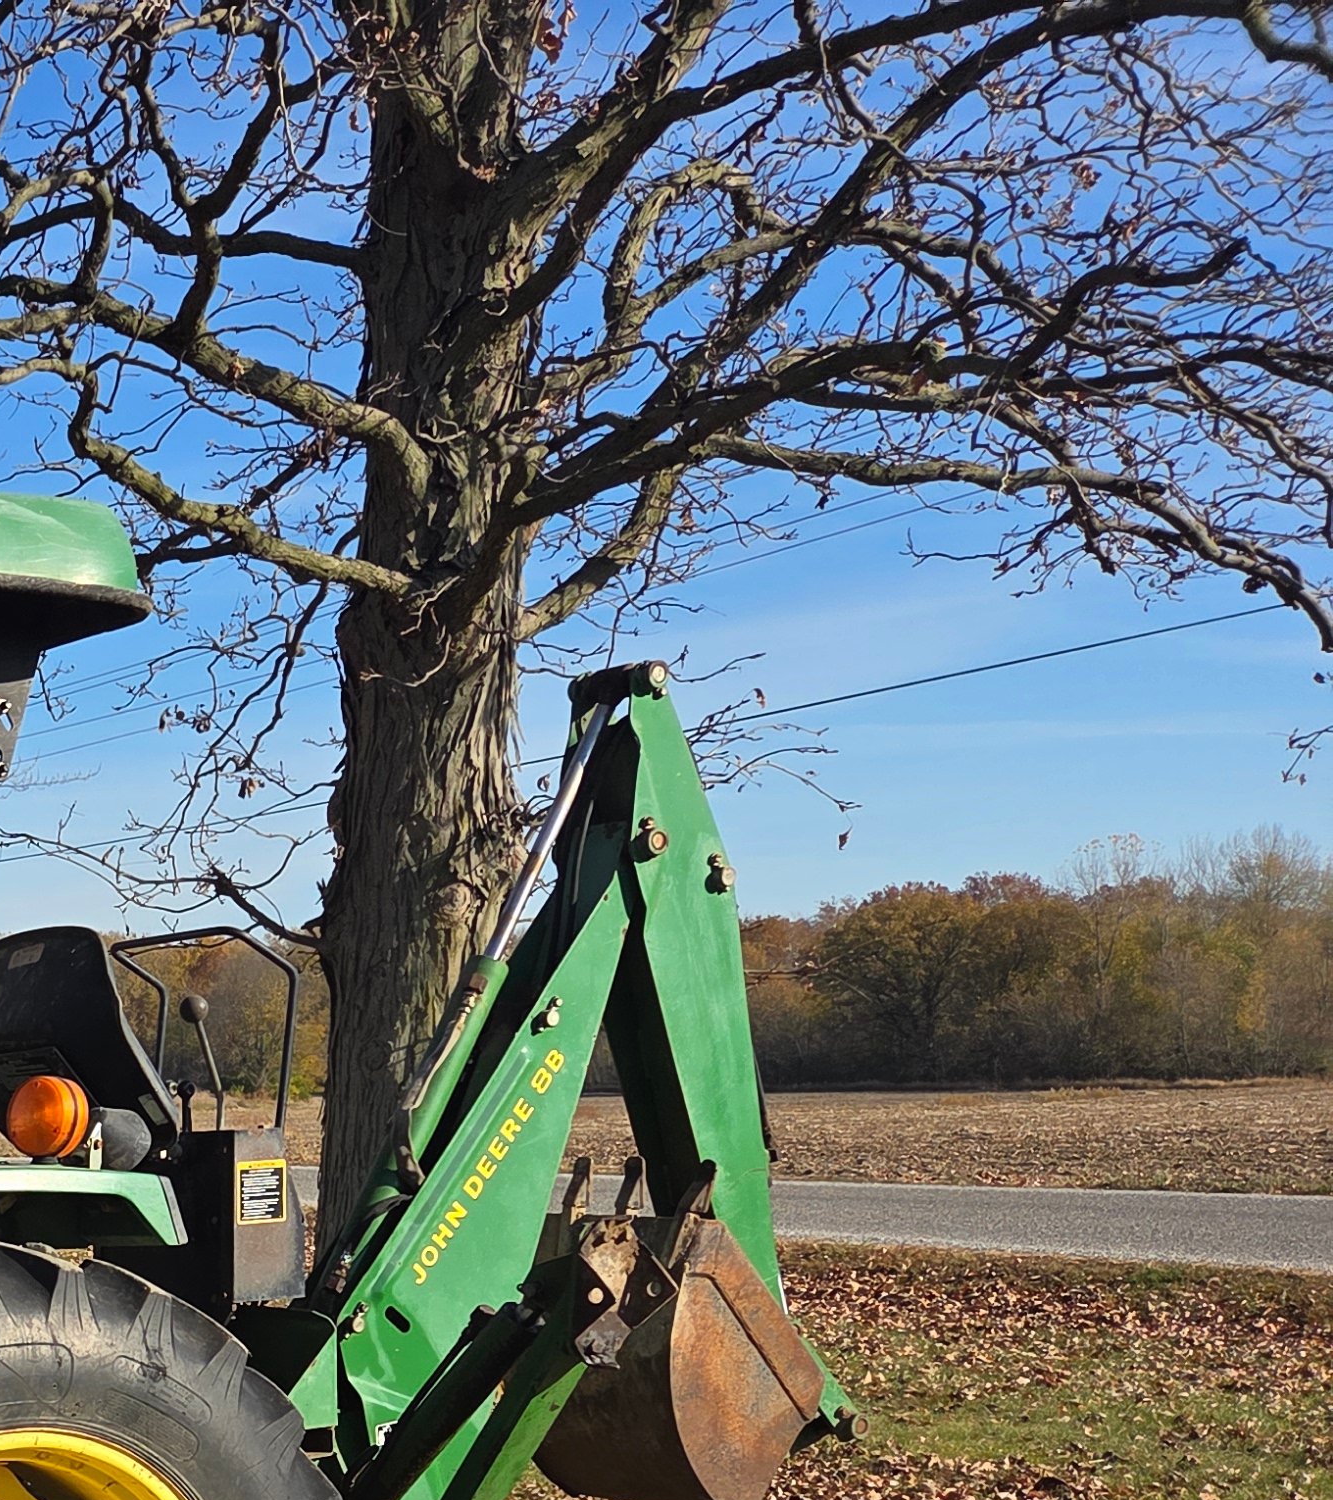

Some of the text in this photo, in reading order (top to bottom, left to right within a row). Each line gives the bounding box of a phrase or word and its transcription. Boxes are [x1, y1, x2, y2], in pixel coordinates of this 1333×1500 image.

[412, 1049, 565, 1285] JOHN DEERE 8B
